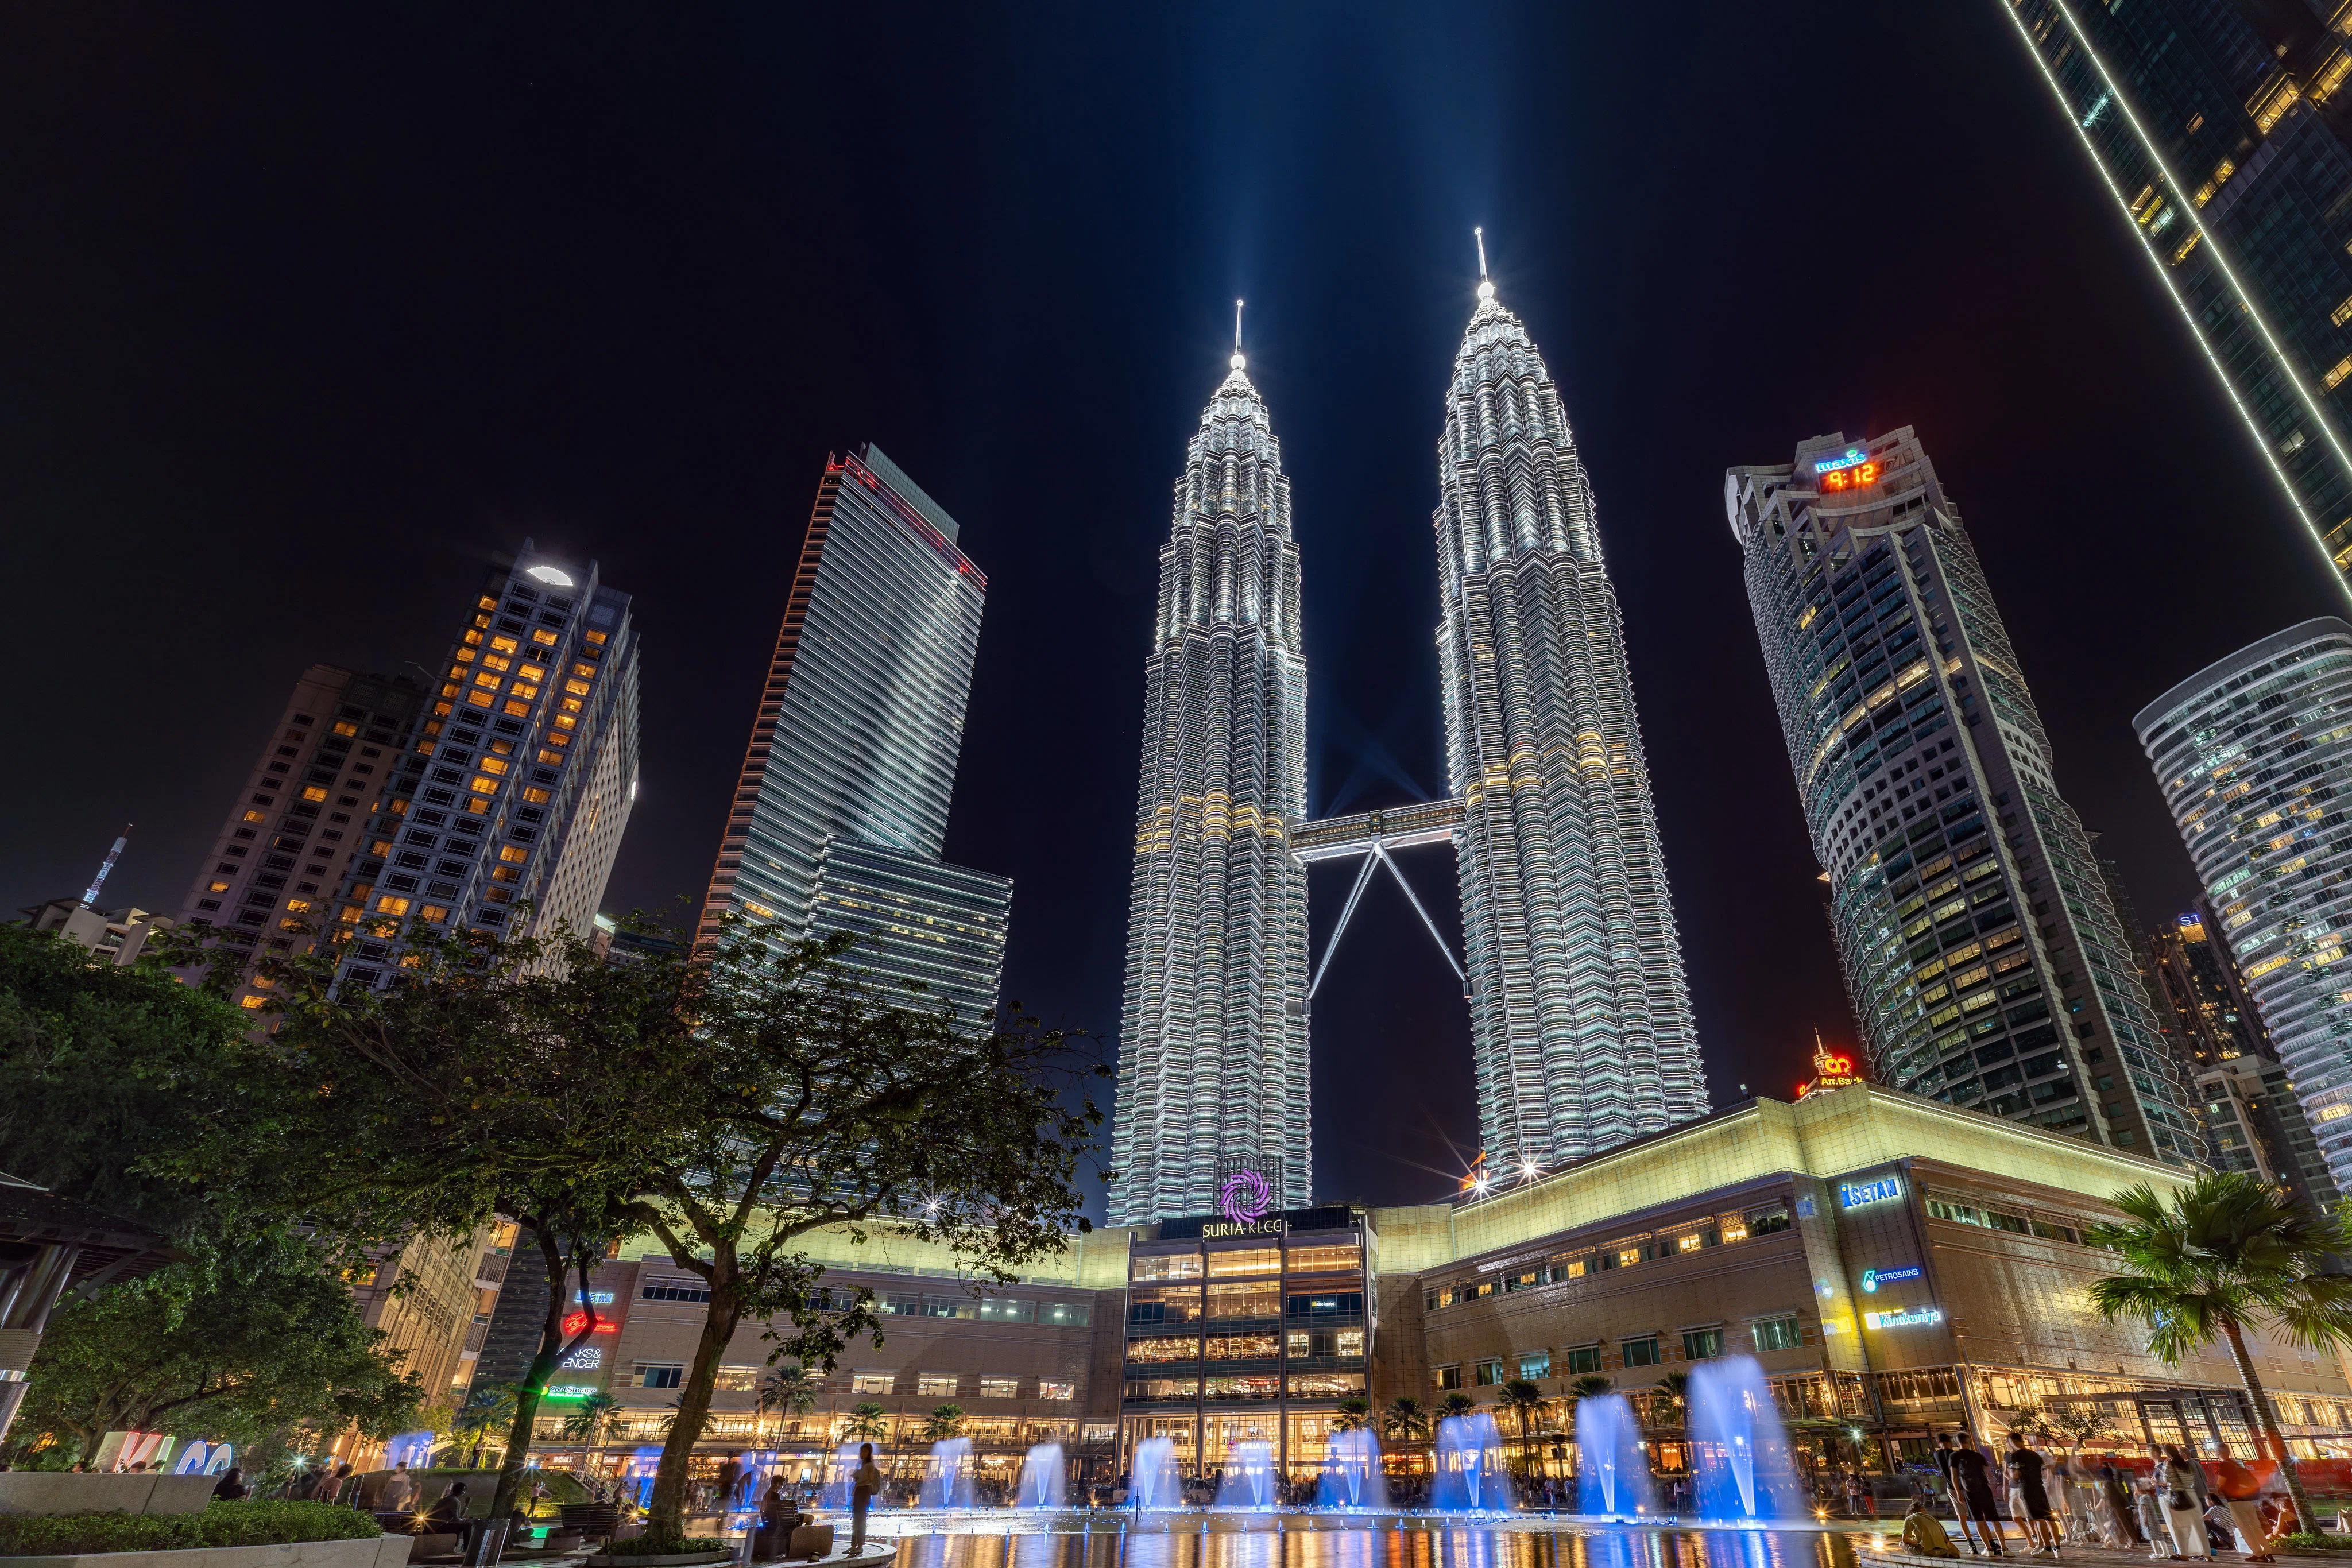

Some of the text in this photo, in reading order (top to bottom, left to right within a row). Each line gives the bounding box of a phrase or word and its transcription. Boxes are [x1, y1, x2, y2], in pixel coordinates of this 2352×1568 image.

[1816, 449, 1867, 473] maxis
[1829, 464, 1873, 486] 9:12
[1203, 1219, 1282, 1237] SURIA KLCC
[1875, 1268, 1919, 1281] PETROSAINS
[1879, 1309, 1941, 1327] Kinokuniya
[563, 1358, 599, 1369] ENCER
[566, 1386, 597, 1395] Storage
